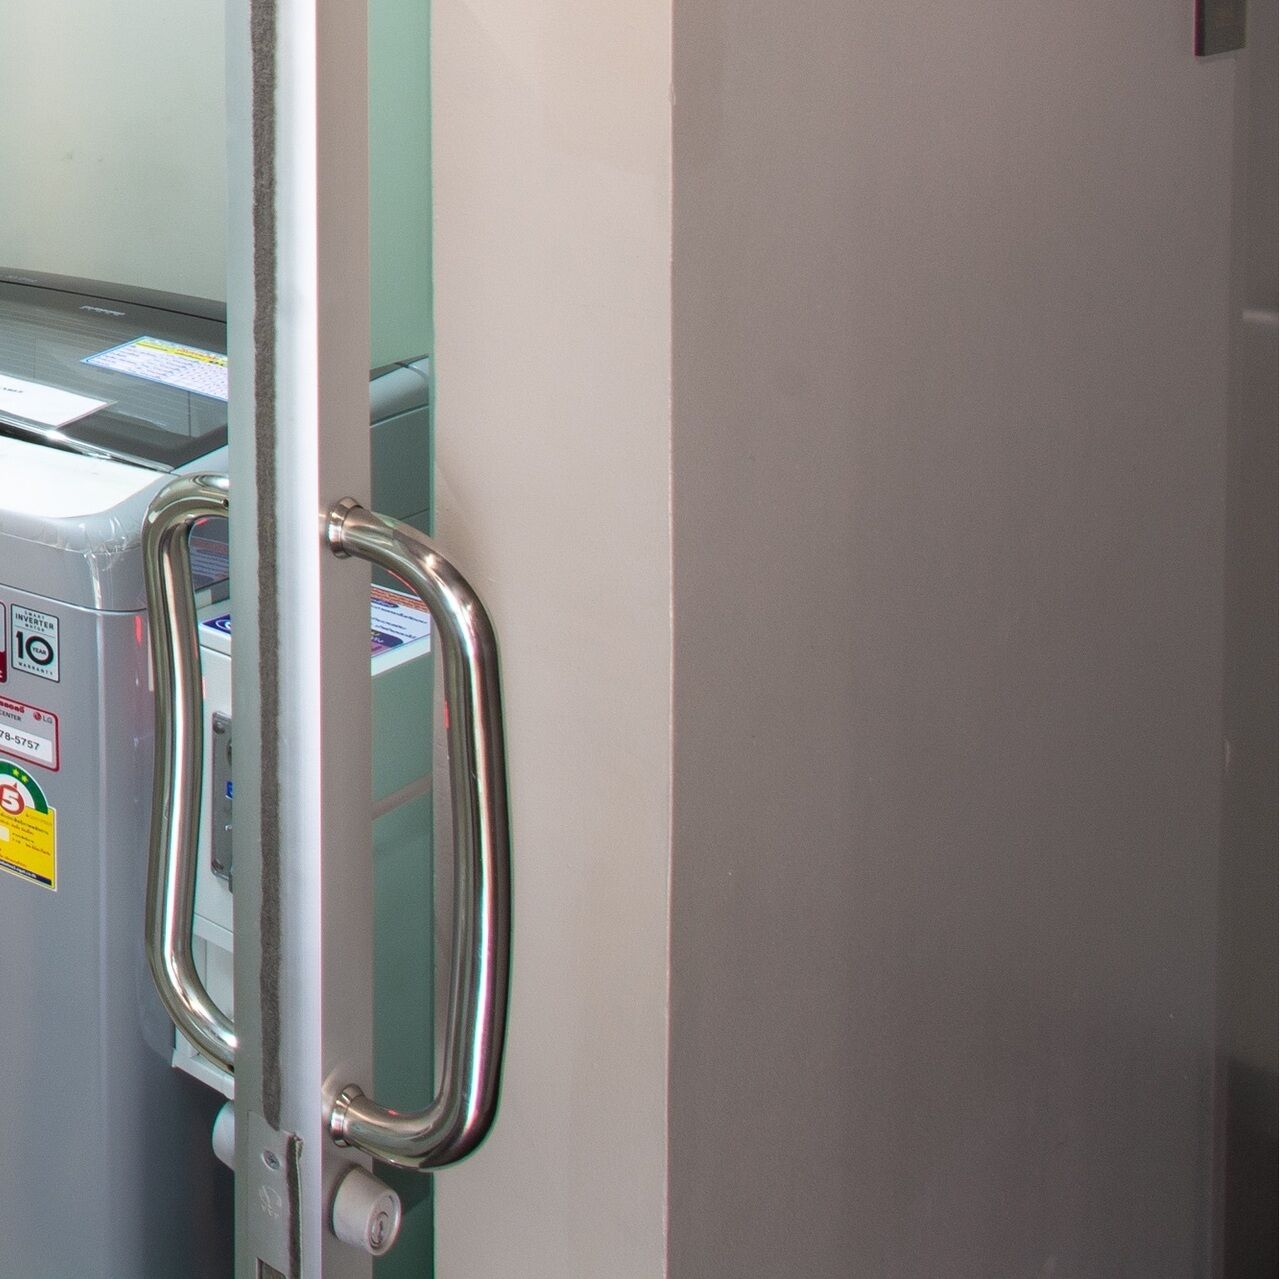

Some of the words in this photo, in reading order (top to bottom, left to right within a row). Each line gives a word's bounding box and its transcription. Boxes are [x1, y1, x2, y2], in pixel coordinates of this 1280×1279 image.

[15, 613, 54, 630] INVERTER
[24, 610, 45, 620] SMART
[16, 630, 54, 666] 10
[31, 647, 47, 656] YEAR
[42, 715, 53, 724] LG
[0, 787, 20, 814] 5
